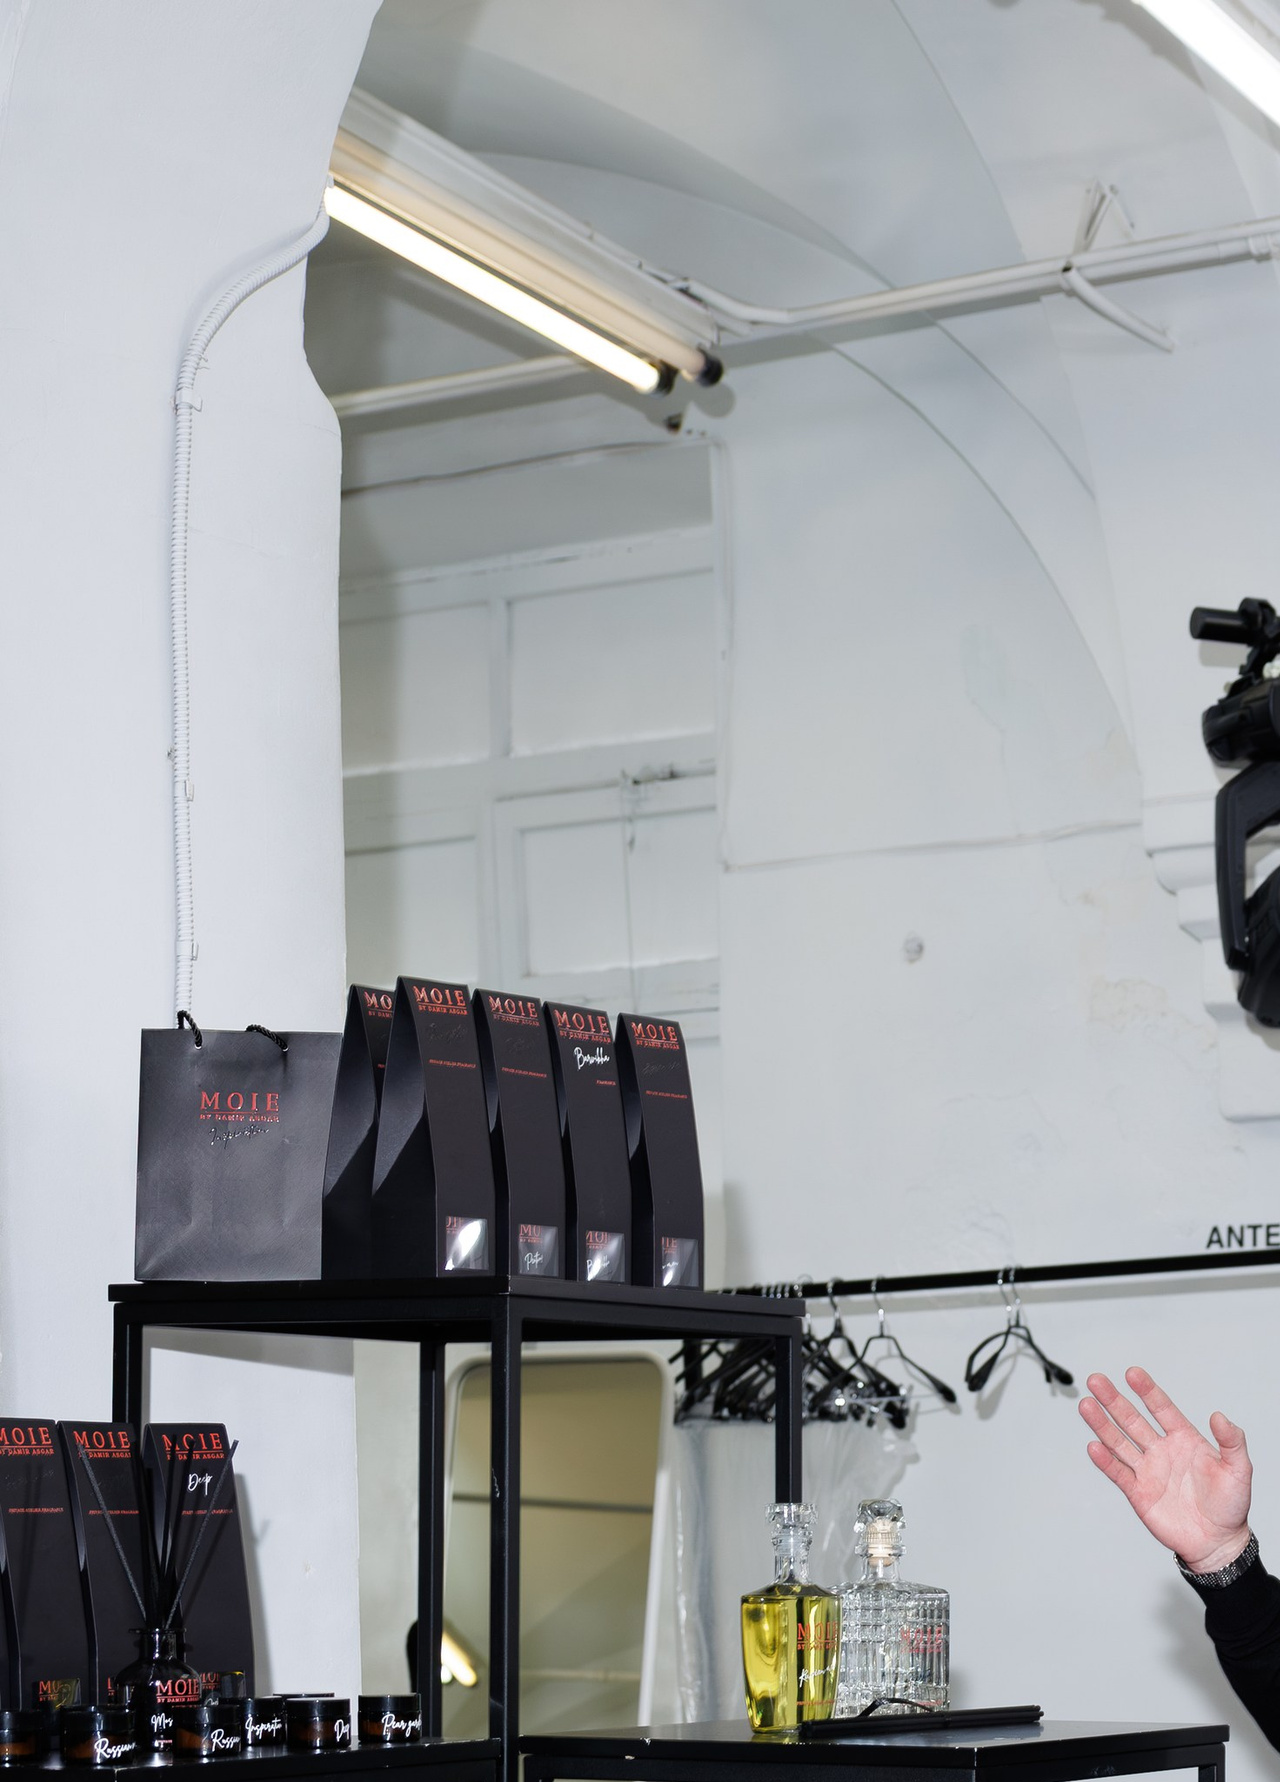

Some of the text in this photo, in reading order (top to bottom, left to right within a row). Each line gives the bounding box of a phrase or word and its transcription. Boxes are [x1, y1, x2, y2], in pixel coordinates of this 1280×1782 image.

[363, 990, 392, 1010] MO
[412, 985, 466, 1007] MOIE
[488, 995, 538, 1018] MOIE
[554, 1009, 610, 1033] MOIE
[631, 1021, 678, 1041] MOIE
[200, 1090, 279, 1112] MOIE
[1206, 1223, 1280, 1249] ANTE
[0, 1427, 52, 1445] MOIE
[73, 1430, 131, 1449] MOIE
[8, 1448, 30, 1457] DAMIR
[32, 1448, 54, 1456] ASGAR
[156, 1678, 200, 1696] MOIE
